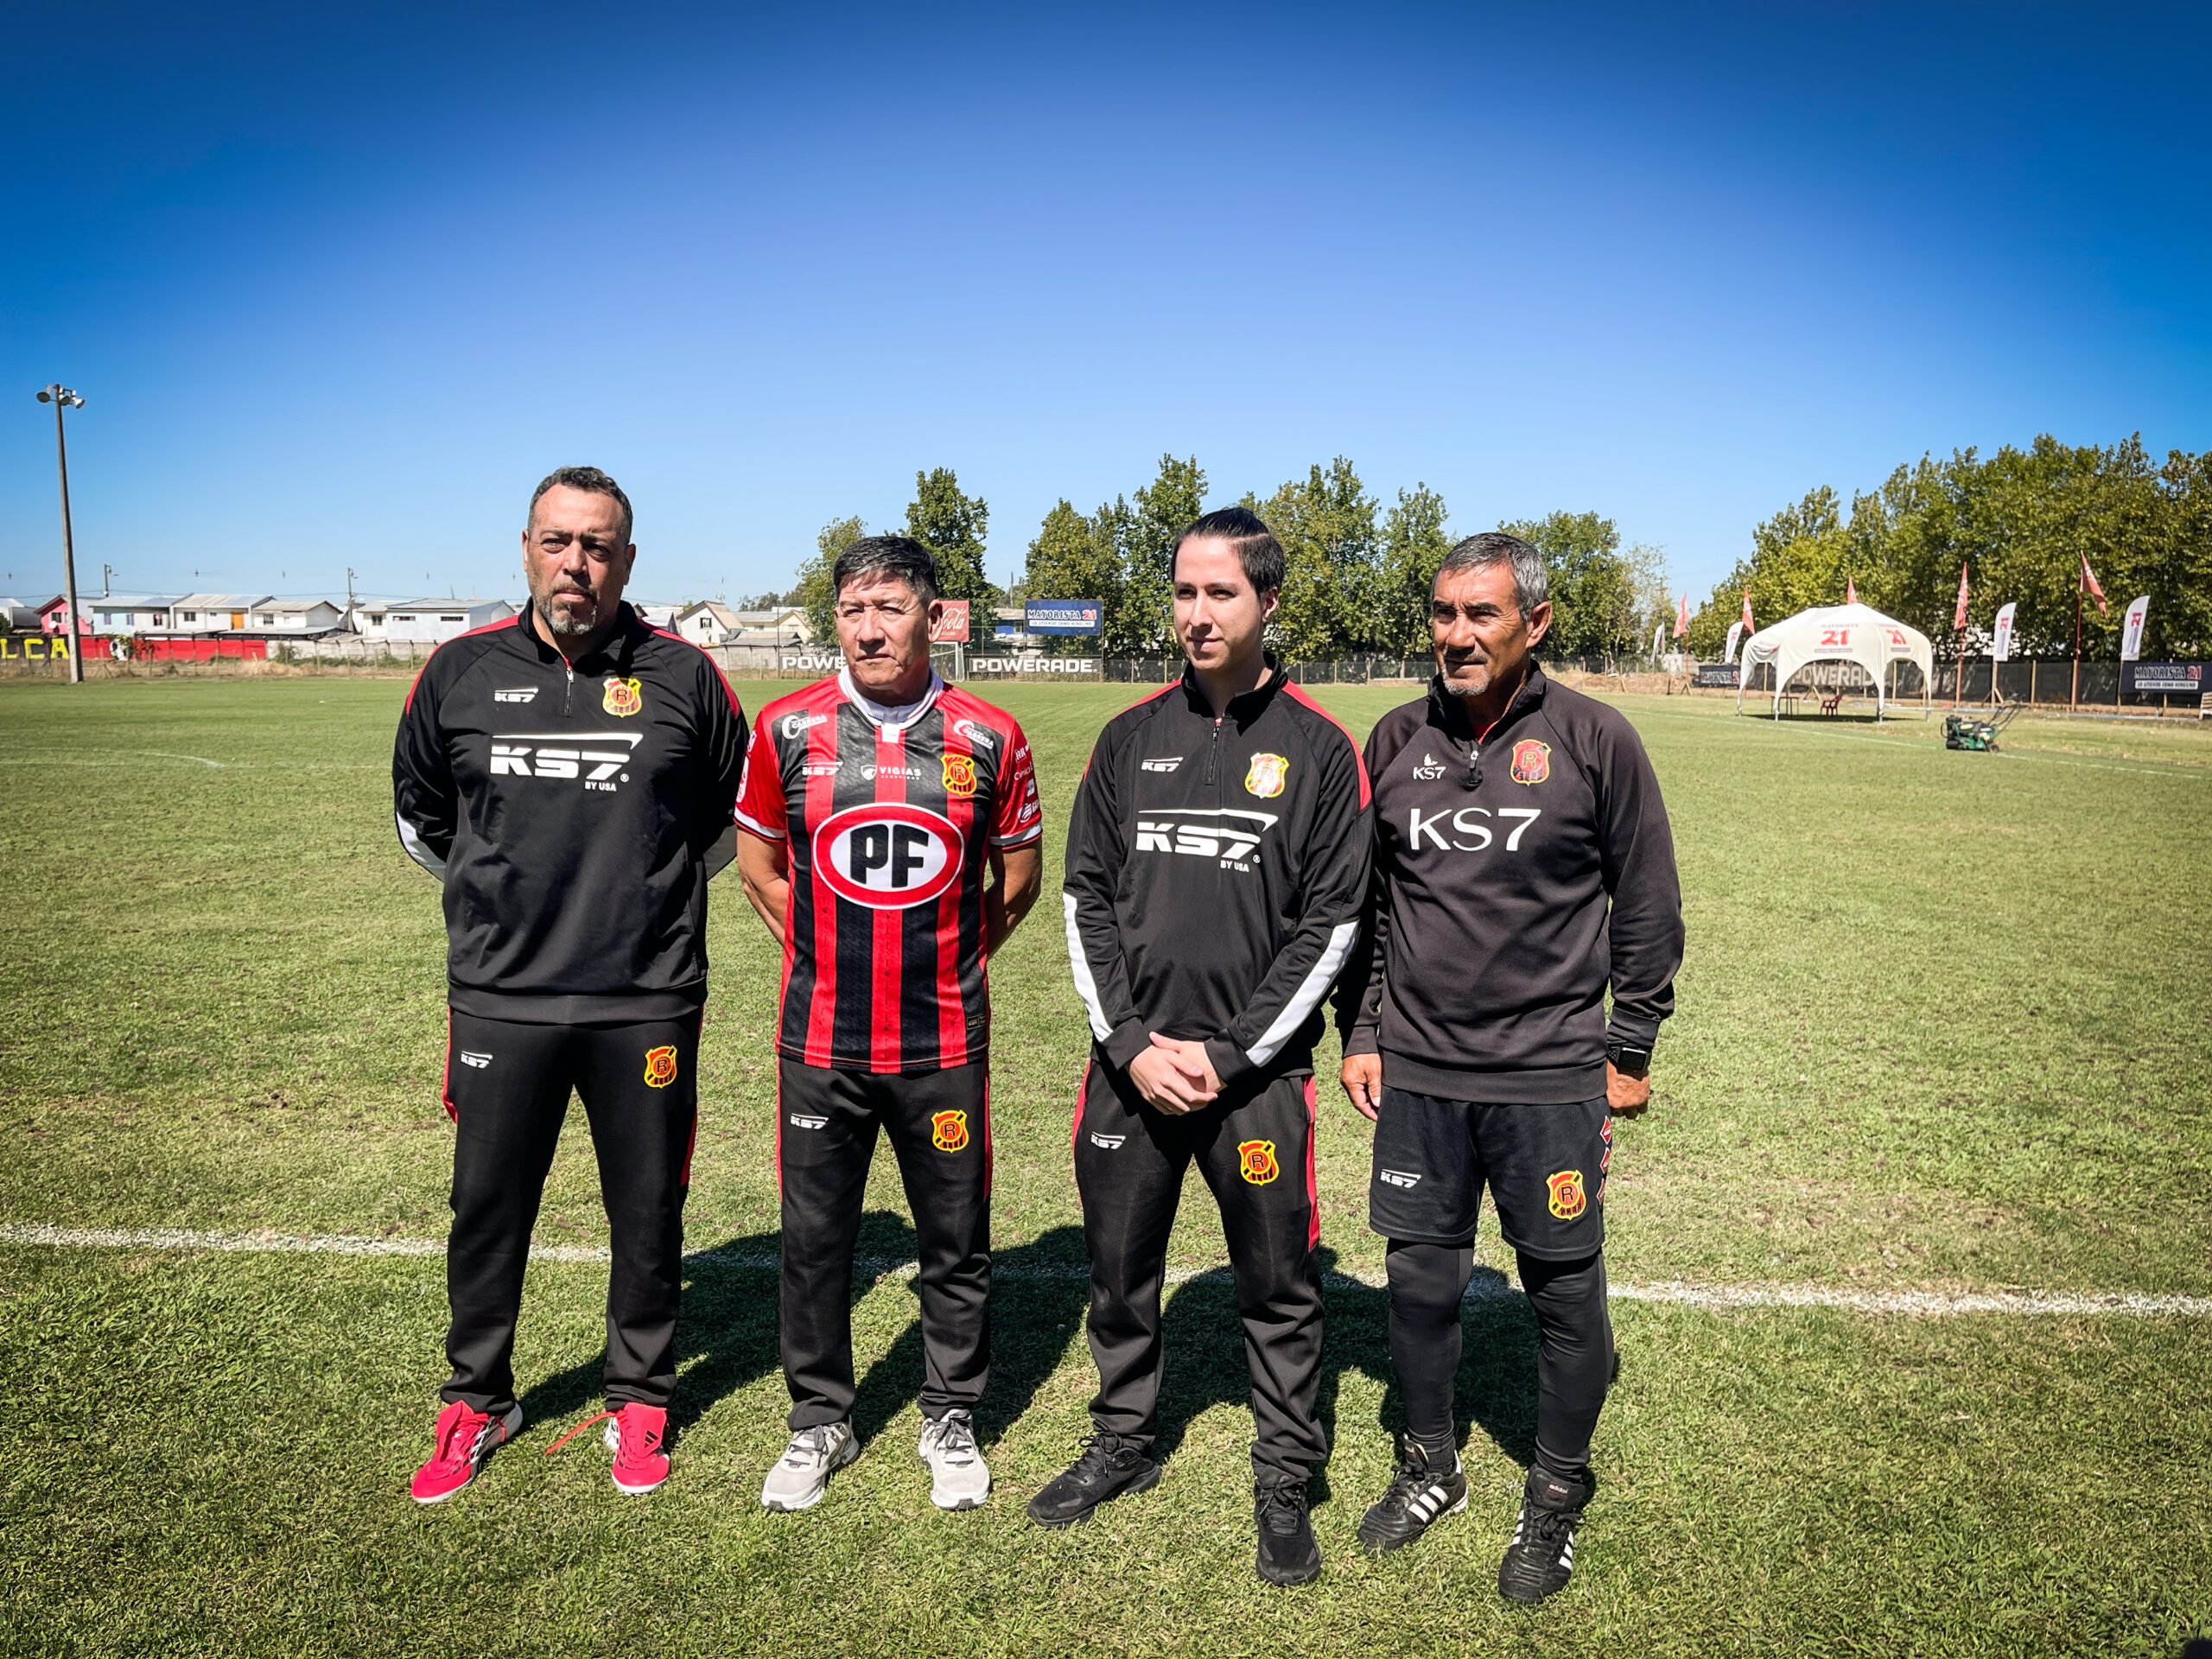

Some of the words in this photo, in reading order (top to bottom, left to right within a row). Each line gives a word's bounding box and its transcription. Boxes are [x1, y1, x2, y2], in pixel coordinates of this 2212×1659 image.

[1027, 609, 1081, 620] MAYORISTA
[1082, 609, 1096, 620] 21
[1820, 629, 1850, 645] 21
[972, 658, 1094, 672] POWERADE
[2134, 666, 2186, 680] MAYORISTA
[2187, 665, 2202, 680] 21
[494, 692, 537, 703] KS7
[616, 689, 627, 702] R
[490, 744, 631, 781] KS7
[1141, 761, 1180, 772] KS7
[1522, 752, 1536, 767] R
[879, 766, 922, 777] VIGIAS
[953, 764, 967, 781] R
[1413, 766, 1446, 780] KS7
[584, 781, 597, 790] BY
[598, 782, 617, 792] USA
[1409, 807, 1542, 852] KS7
[1136, 821, 1262, 861] KS7
[850, 823, 930, 888] PF
[1220, 860, 1233, 869] BY
[1234, 861, 1249, 873] USA
[461, 1053, 491, 1069] KS7
[657, 1059, 667, 1074] R
[790, 1115, 827, 1130] KS7
[944, 1123, 956, 1138] R
[1090, 1133, 1123, 1150] KS7
[1250, 1154, 1264, 1168] R
[1380, 1171, 1418, 1188] KS7
[1560, 1185, 1573, 1202] R
